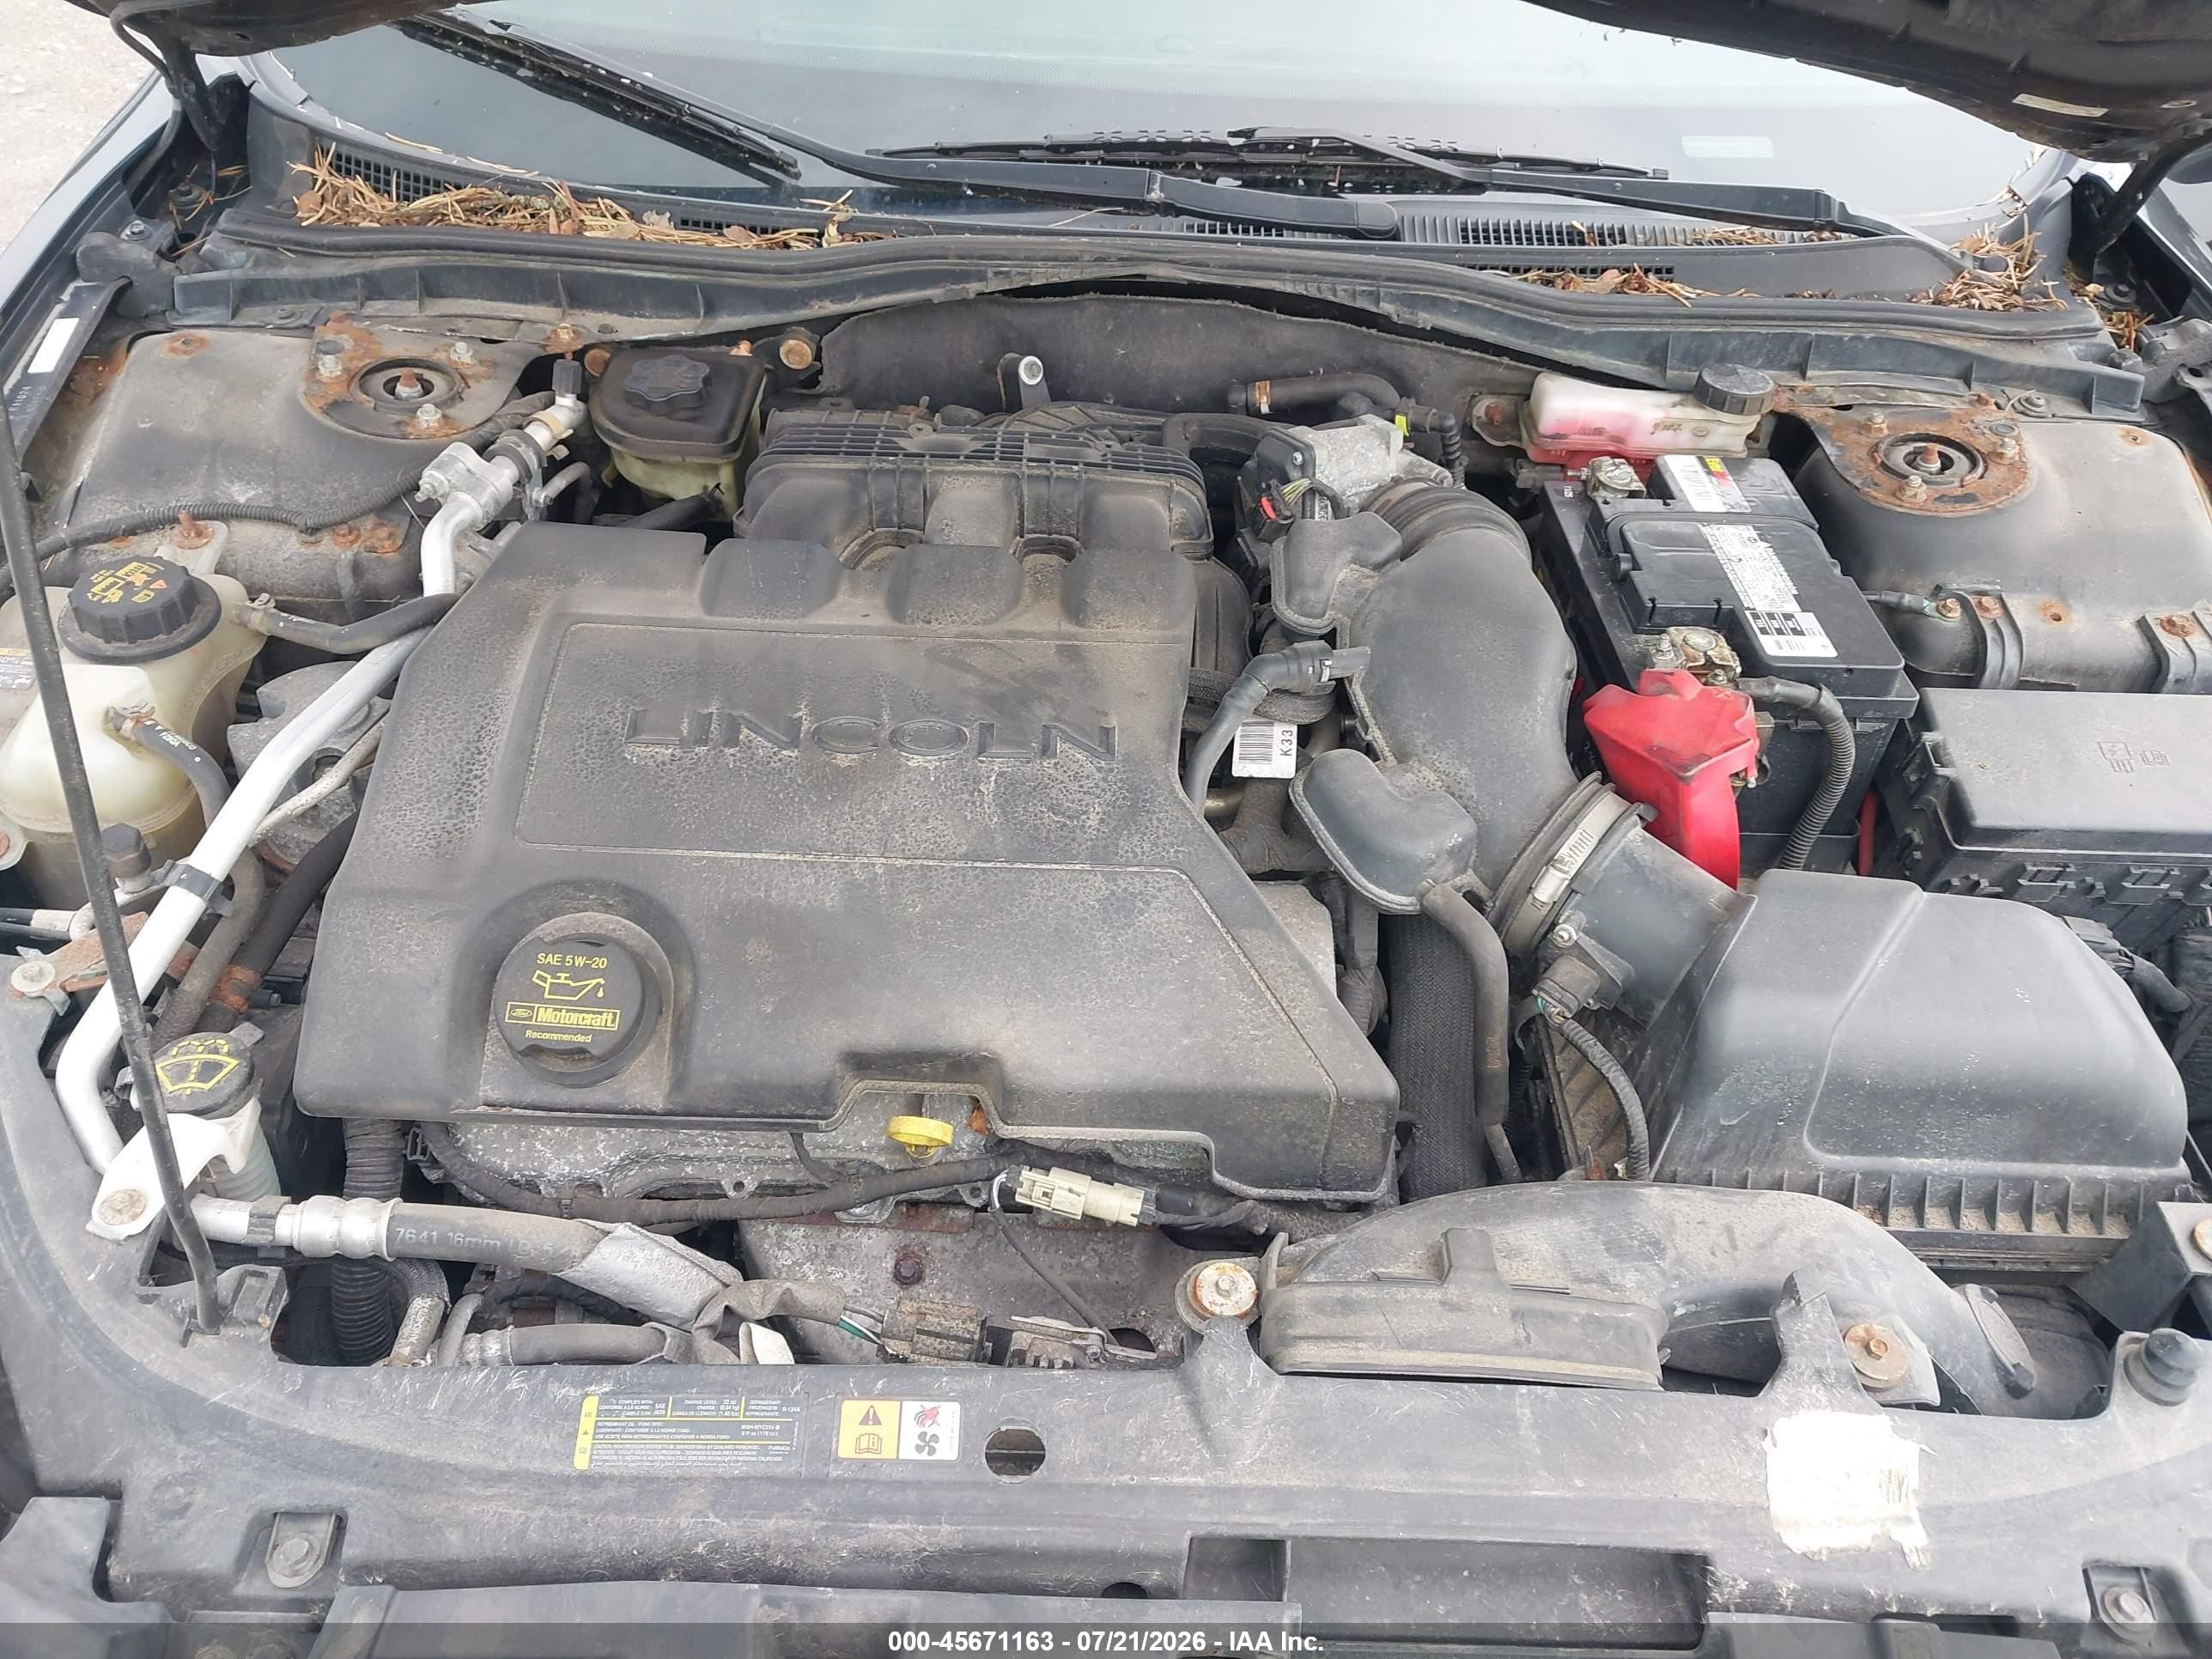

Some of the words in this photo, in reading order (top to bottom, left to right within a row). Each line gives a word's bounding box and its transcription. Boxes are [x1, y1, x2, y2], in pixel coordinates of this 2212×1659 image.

[623, 708, 1116, 763] LINCOLN
[1279, 730, 1293, 757] K33
[537, 952, 562, 966] SAE
[564, 954, 608, 969] 5W-20
[525, 1030, 592, 1044] Recommended
[394, 1227, 438, 1245] 7641
